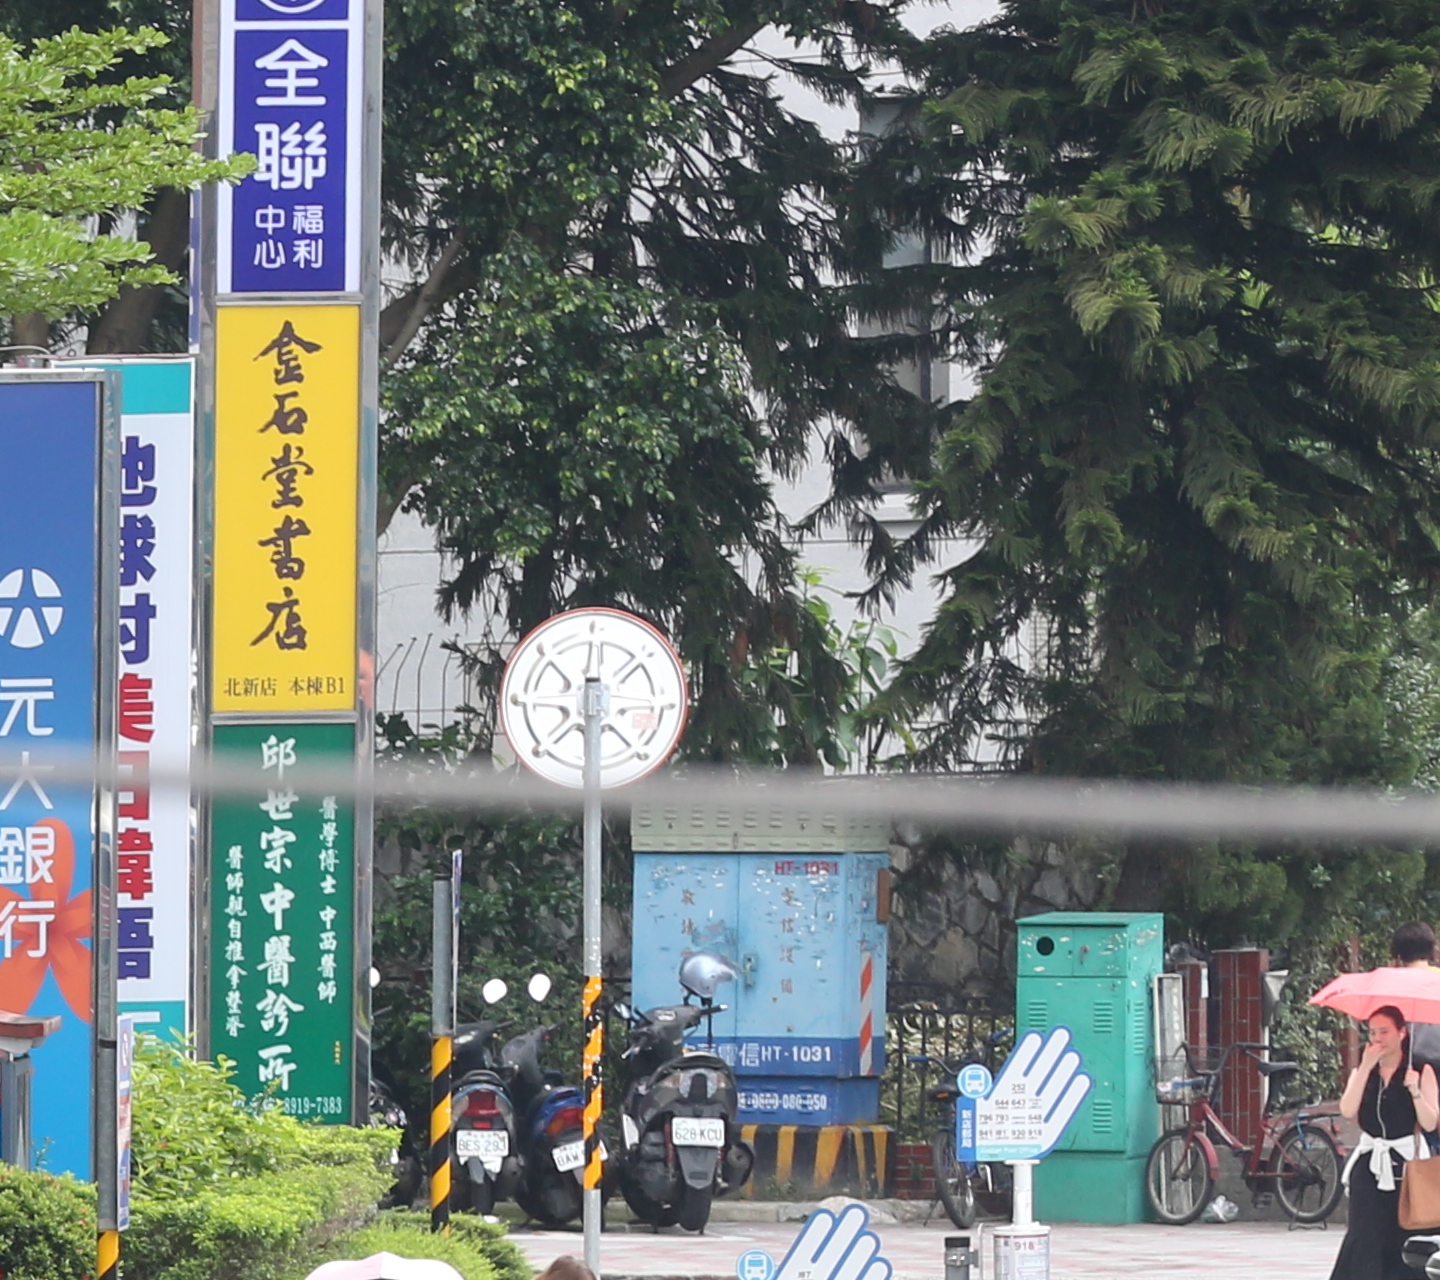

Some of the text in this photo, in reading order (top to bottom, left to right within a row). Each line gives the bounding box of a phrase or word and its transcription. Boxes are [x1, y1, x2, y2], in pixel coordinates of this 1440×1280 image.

[254, 39, 328, 190] 全聯
[254, 205, 286, 269] 中心
[292, 205, 324, 269] 福利
[250, 320, 322, 650] 金石堂書店
[223, 677, 277, 697] 北新店
